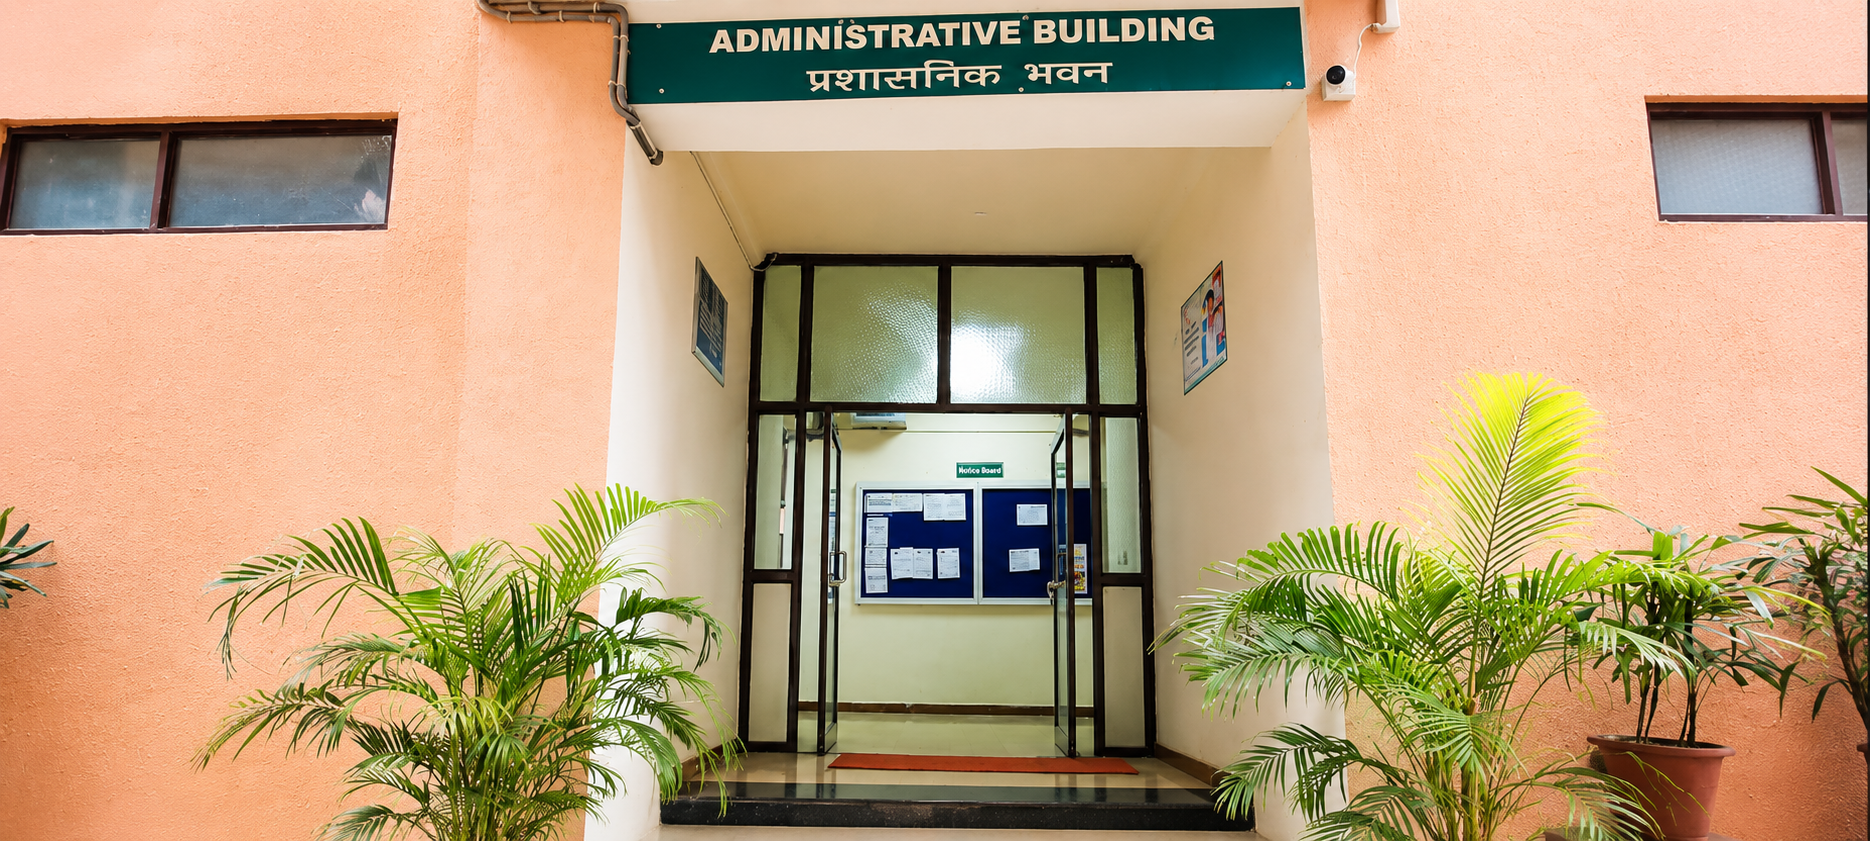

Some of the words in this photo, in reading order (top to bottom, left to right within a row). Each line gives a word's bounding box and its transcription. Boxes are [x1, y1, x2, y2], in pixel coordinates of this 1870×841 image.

[709, 20, 1022, 53] ADMINISTRATIVE
[1033, 16, 1215, 44] BUILDING
[806, 59, 1002, 92] प्रशासनिक
[1024, 62, 1113, 84] भवन
[958, 465, 980, 474] Notice
[981, 466, 1002, 474] Board
